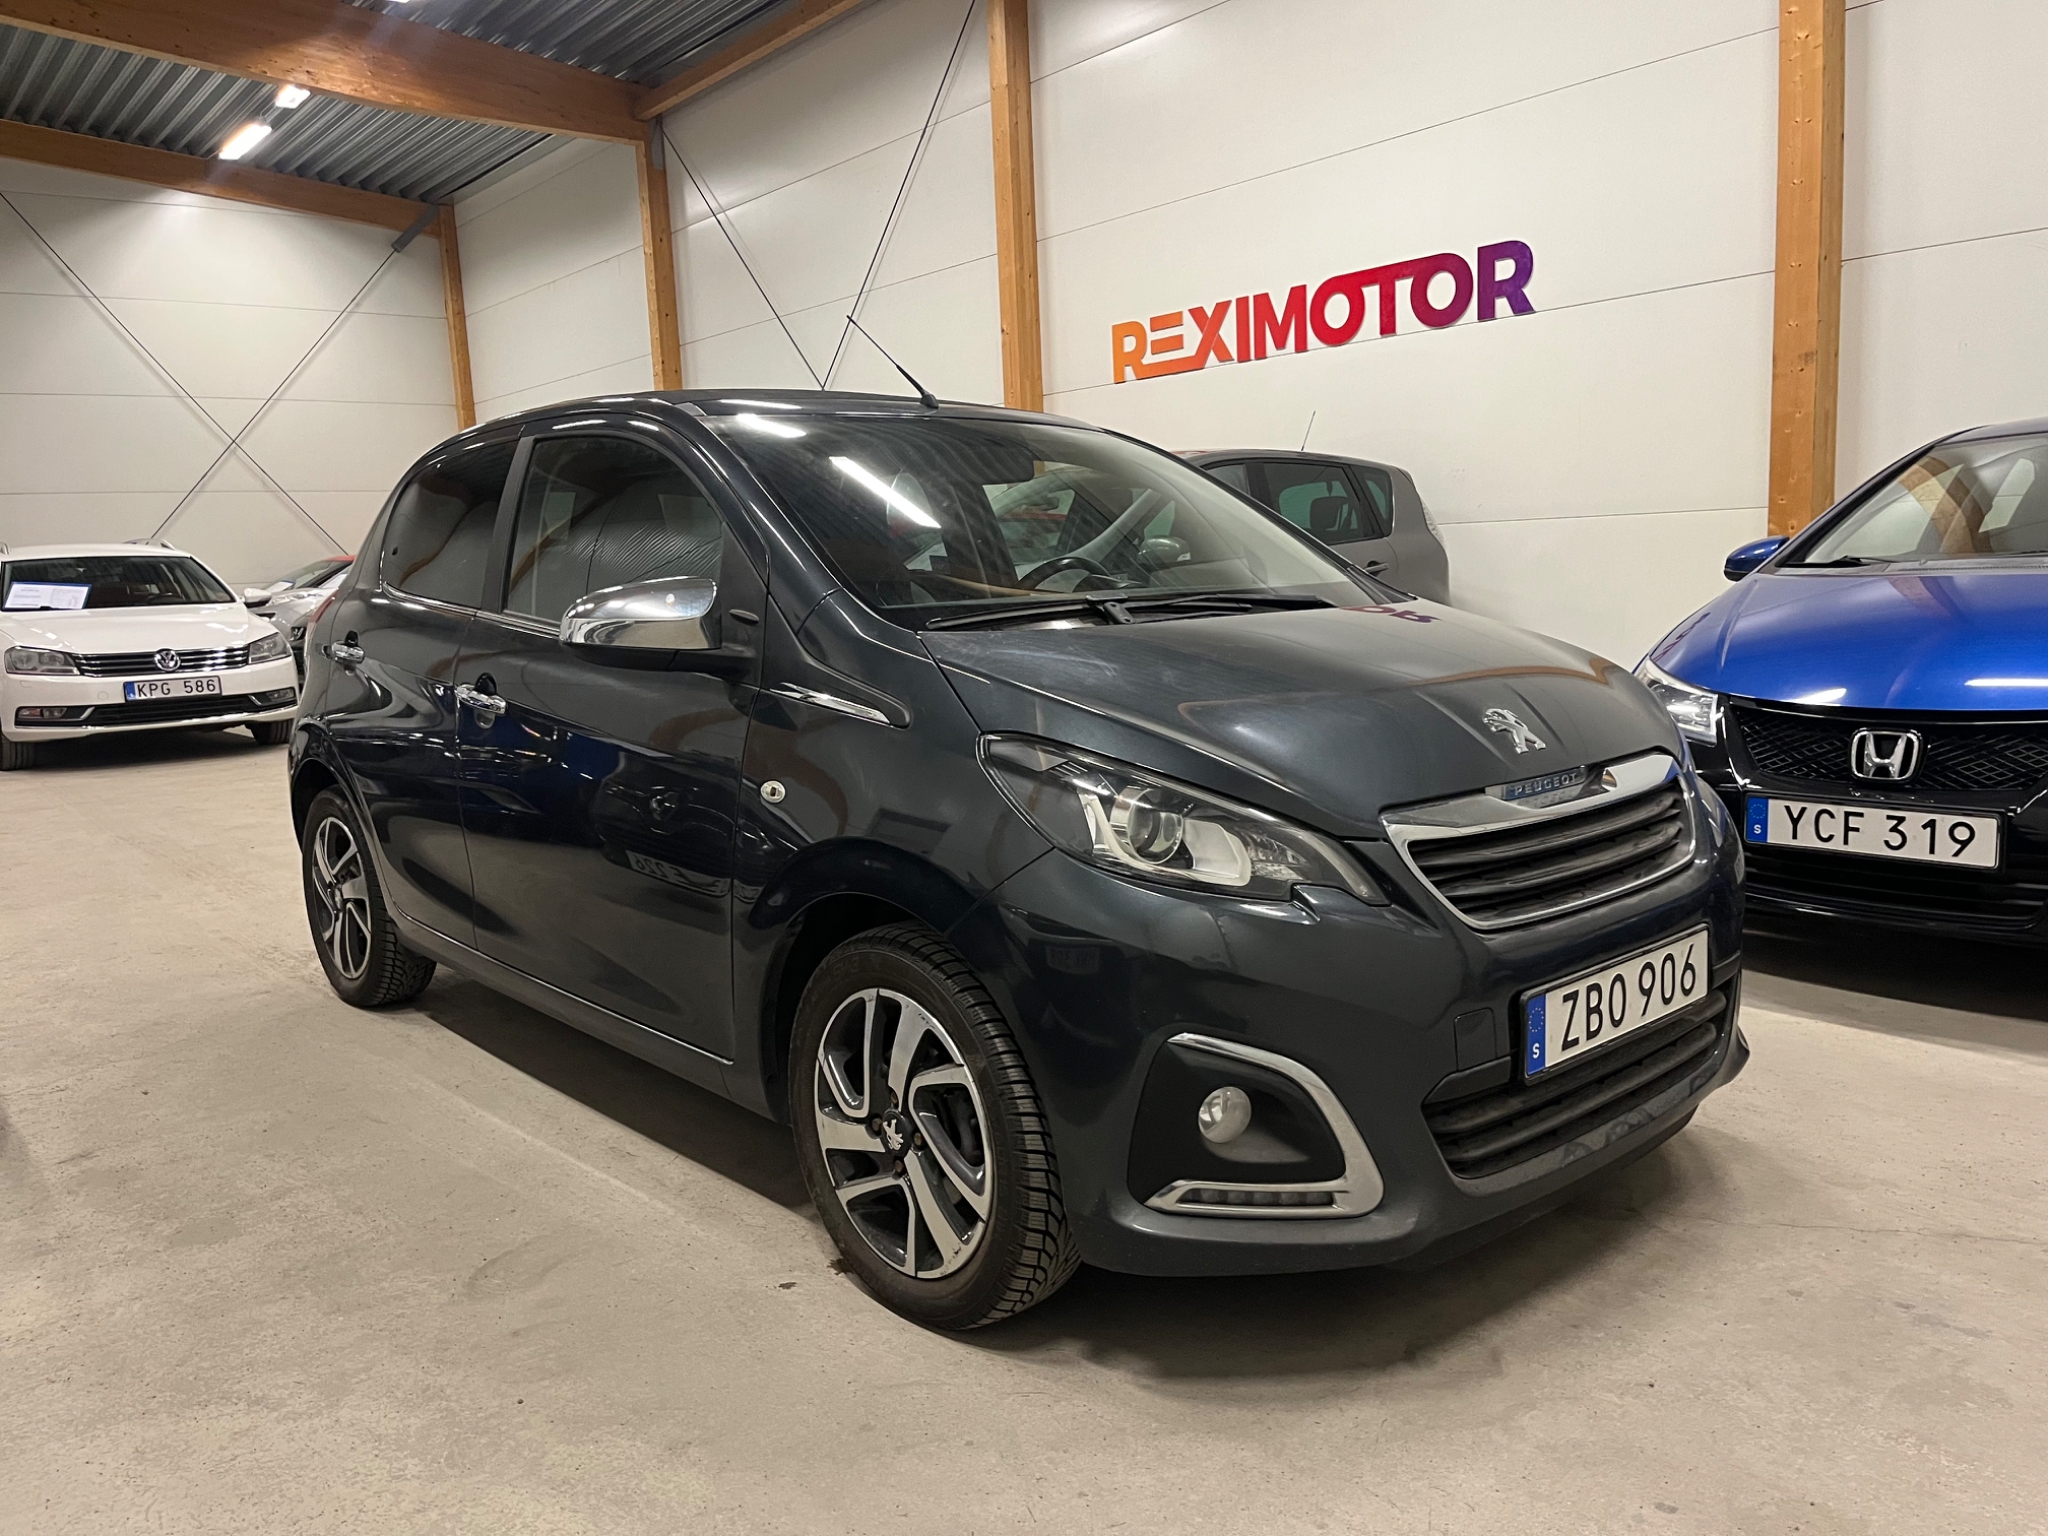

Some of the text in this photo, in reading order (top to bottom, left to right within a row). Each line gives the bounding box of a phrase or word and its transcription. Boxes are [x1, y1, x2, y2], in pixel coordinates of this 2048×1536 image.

[1111, 239, 1537, 384] REXIMOTOR
[137, 679, 216, 698] KPG 586
[1514, 772, 1577, 796] PEUGEOT
[1753, 824, 1762, 834] S
[1783, 805, 1976, 857] YCF 319
[1561, 943, 1696, 1052] ZBO 906
[1532, 1042, 1540, 1059] S
